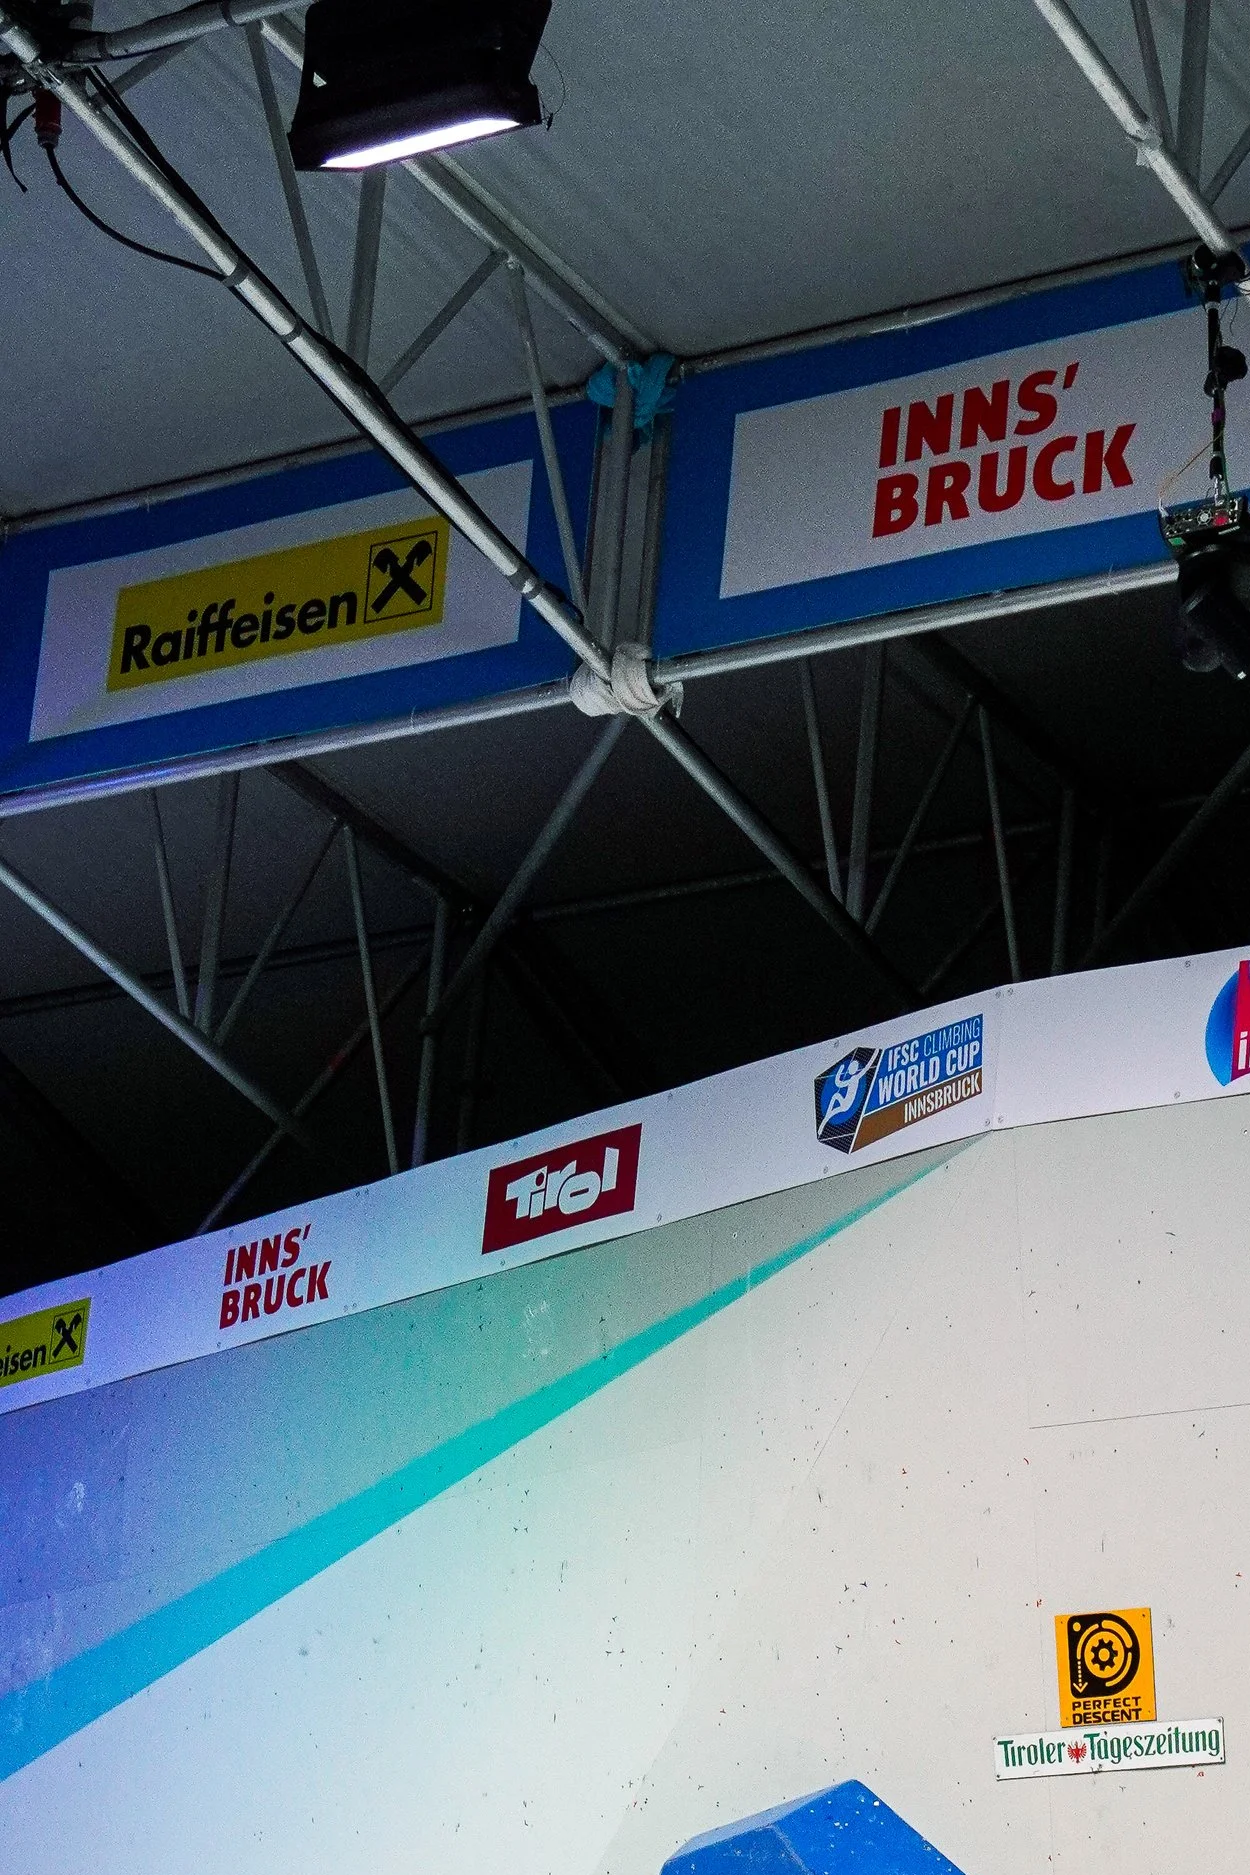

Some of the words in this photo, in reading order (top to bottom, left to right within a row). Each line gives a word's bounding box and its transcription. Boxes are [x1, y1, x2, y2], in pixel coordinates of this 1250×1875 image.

[877, 361, 1080, 469] INNS'
[871, 422, 1138, 539] BRUCK
[119, 589, 358, 674] Raiffeisen
[877, 1056, 940, 1106] WORLD
[945, 1040, 981, 1076] CUP
[887, 1039, 919, 1072] IFSC
[923, 1017, 980, 1057] CLIMBING
[903, 1071, 982, 1124] INNSBRUCK
[504, 1146, 620, 1219] Tirol
[223, 1223, 311, 1287] INNS'
[218, 1260, 332, 1330] BRUCK
[1071, 1696, 1142, 1712] PERFECT
[1072, 1708, 1143, 1725] DESCENT
[997, 1737, 1067, 1768] Tiroler
[1083, 1726, 1221, 1765] Tageszeitung
